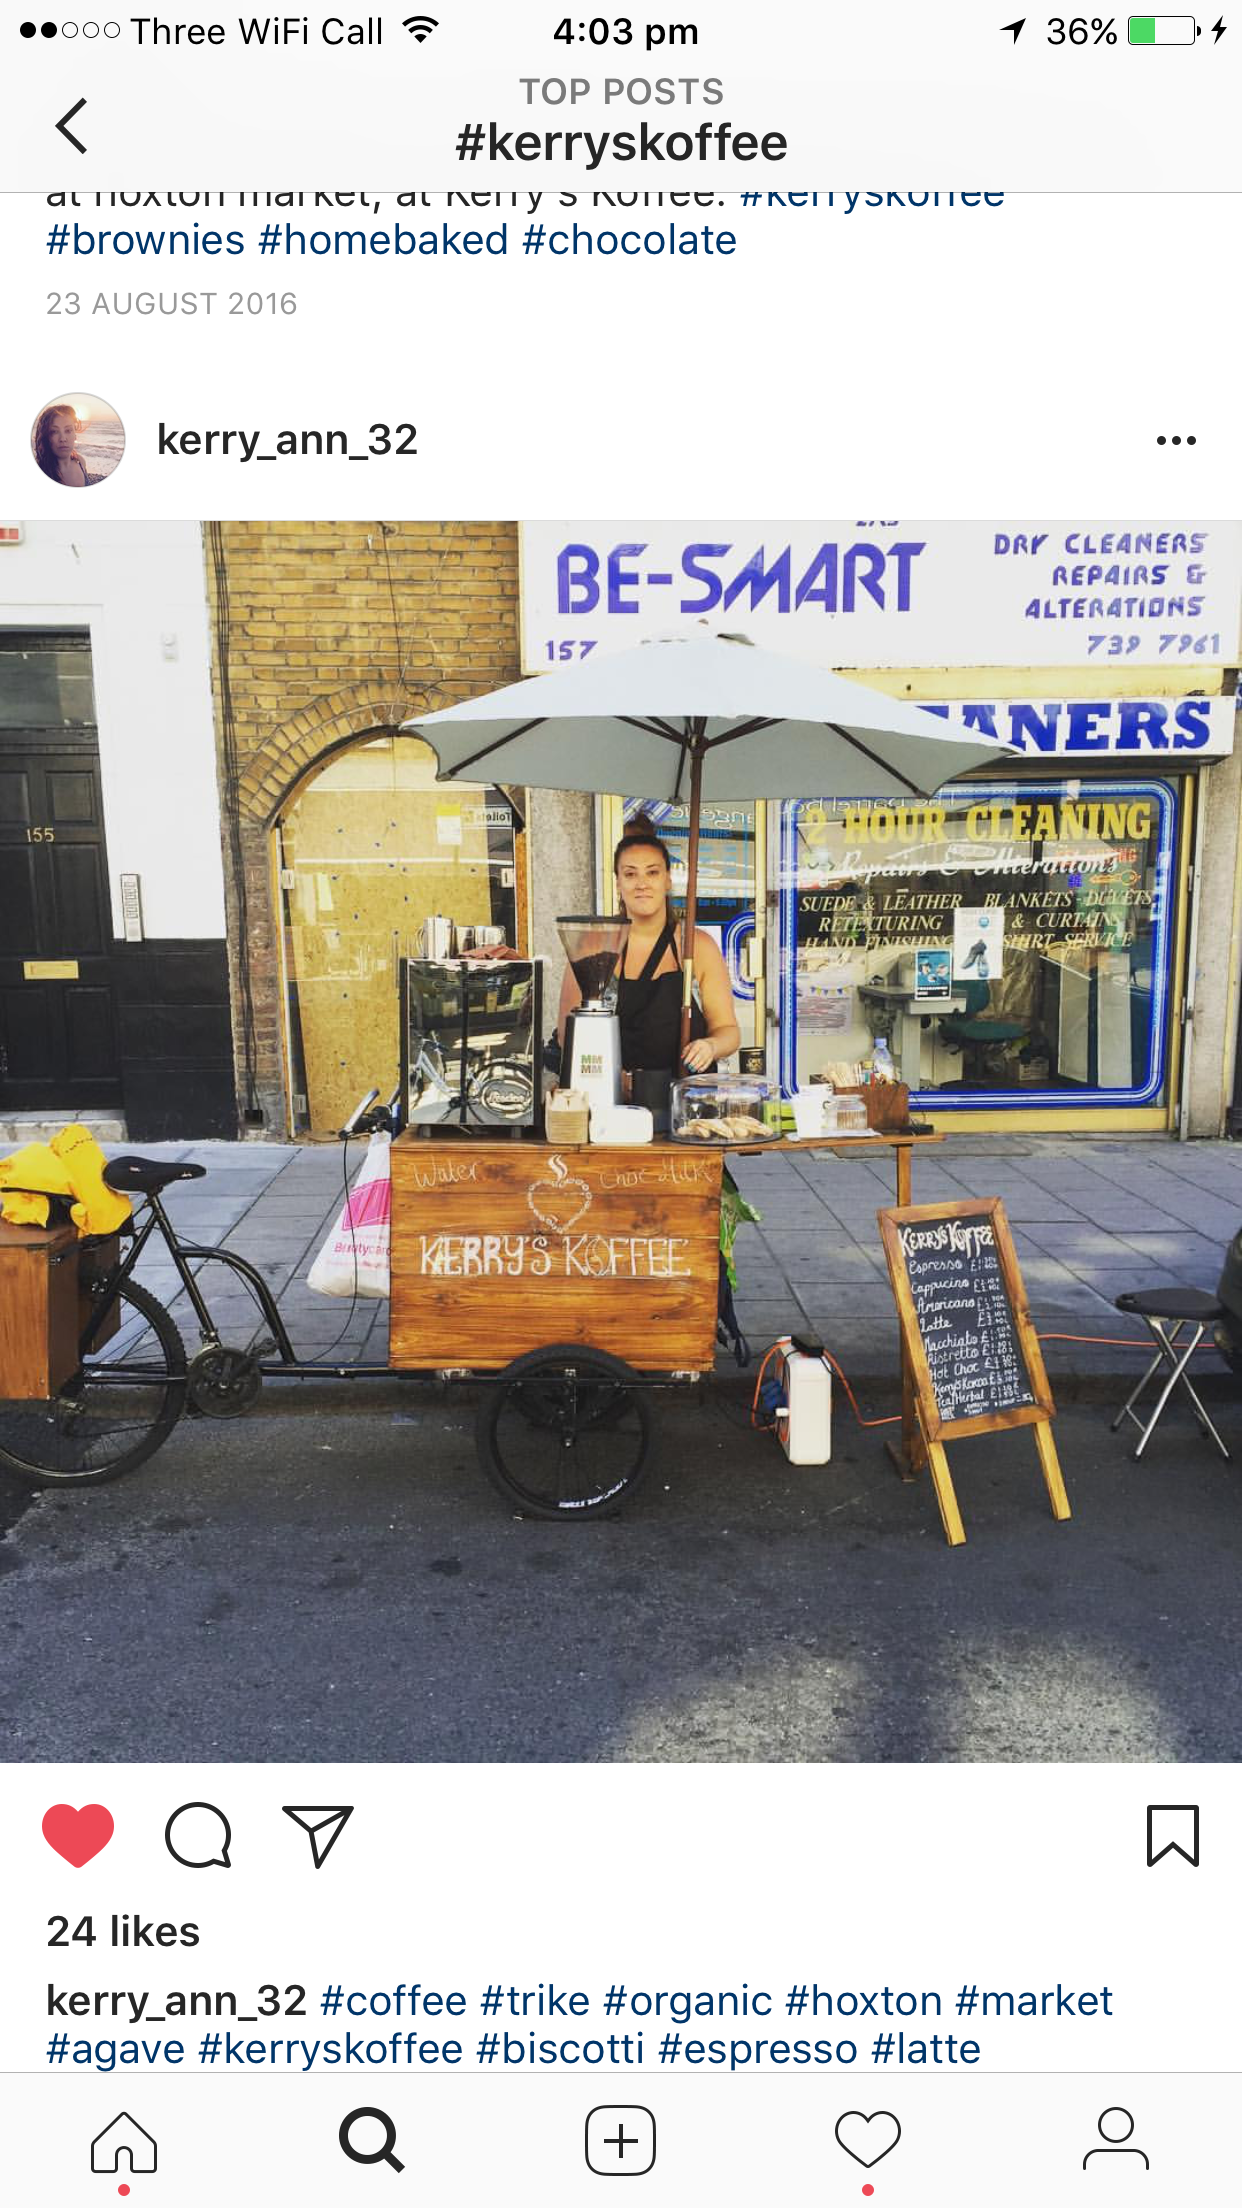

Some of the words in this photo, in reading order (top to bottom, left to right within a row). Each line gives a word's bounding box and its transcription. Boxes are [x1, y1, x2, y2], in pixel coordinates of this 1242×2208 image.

[993, 533, 1049, 556] DRY
[1065, 532, 1208, 555] CLEANERS
[556, 542, 928, 615] BE-SMART
[1052, 563, 1170, 586] REPAIRS
[1186, 563, 1207, 585] &
[1024, 596, 1206, 619] ALTERATIONS
[545, 640, 598, 661] 157
[1087, 635, 1141, 655] 739
[1159, 633, 1221, 655] 7961
[805, 807, 828, 844] 2
[845, 807, 949, 844] HOUR
[966, 803, 1151, 843] CLEANING
[26, 828, 55, 843] 155
[800, 896, 857, 912] SUEDE
[883, 894, 963, 911] LEATHER
[984, 892, 1075, 908] BLANKETS
[1085, 890, 1152, 906] DUVETS
[819, 915, 943, 932] RETEXTURING
[1036, 912, 1121, 928] CURTAINS
[411, 1159, 483, 1189] Water
[419, 1234, 553, 1277] KERRY'S
[909, 1259, 963, 1276] Espresso
[920, 1315, 953, 1333] Latte
